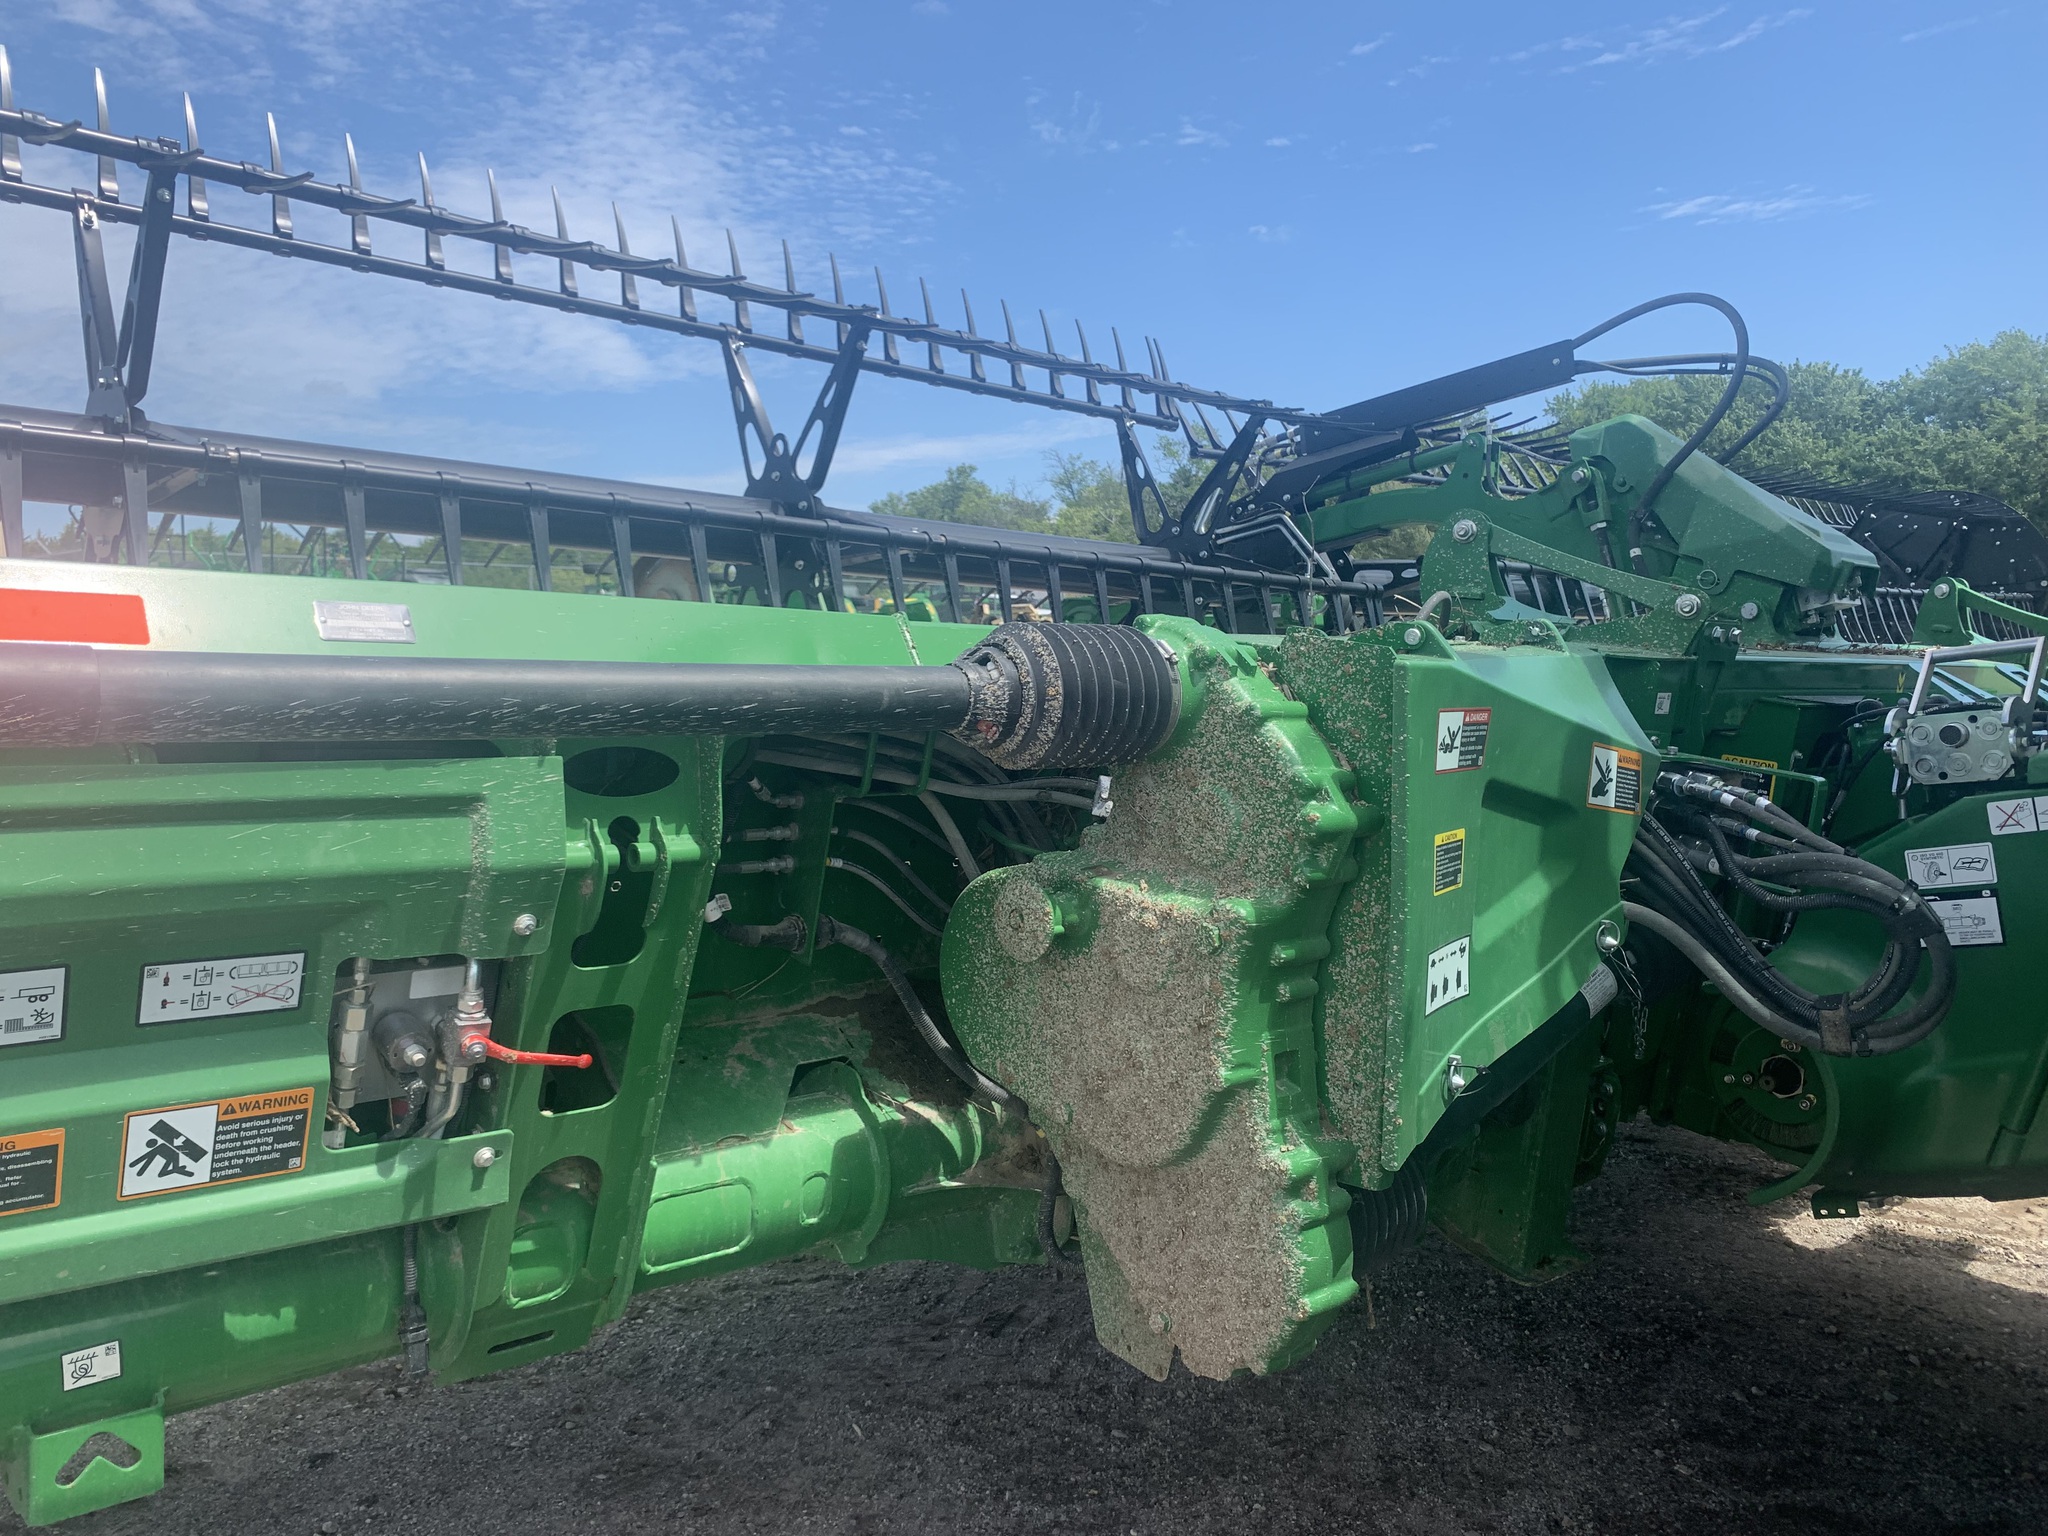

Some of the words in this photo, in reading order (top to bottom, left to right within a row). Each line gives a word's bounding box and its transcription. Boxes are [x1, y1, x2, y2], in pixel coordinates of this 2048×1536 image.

[239, 1094, 308, 1112] WARNING
[217, 1122, 239, 1131] Avoid
[242, 1119, 270, 1128] serious
[272, 1115, 293, 1124] injury
[216, 1132, 238, 1141] death
[240, 1128, 257, 1137] from
[260, 1124, 294, 1134] crushing.
[215, 1141, 241, 1150] Before
[243, 1136, 273, 1145] working
[214, 1148, 258, 1159] underneath
[245, 1152, 280, 1164] hydraulic
[212, 1168, 242, 1178] system.
